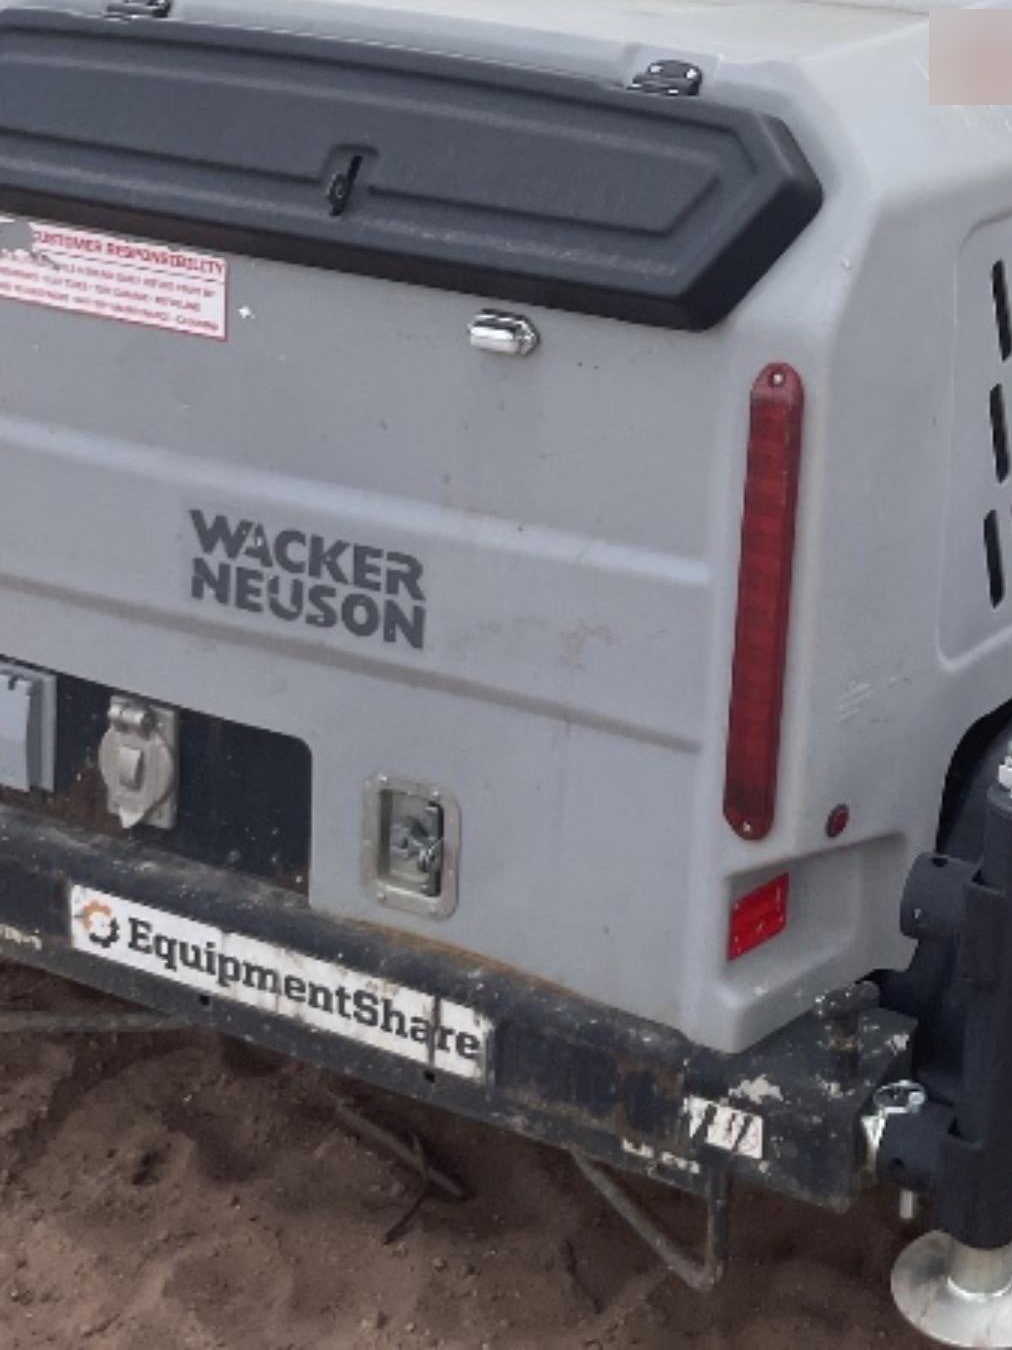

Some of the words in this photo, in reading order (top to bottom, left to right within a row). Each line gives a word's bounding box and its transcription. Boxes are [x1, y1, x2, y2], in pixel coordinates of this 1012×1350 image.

[106, 242, 224, 274] RESPONSIBILITY
[189, 508, 426, 602] WACKER
[191, 556, 427, 651] NEUSON
[127, 915, 481, 1060] EquipmentShare
